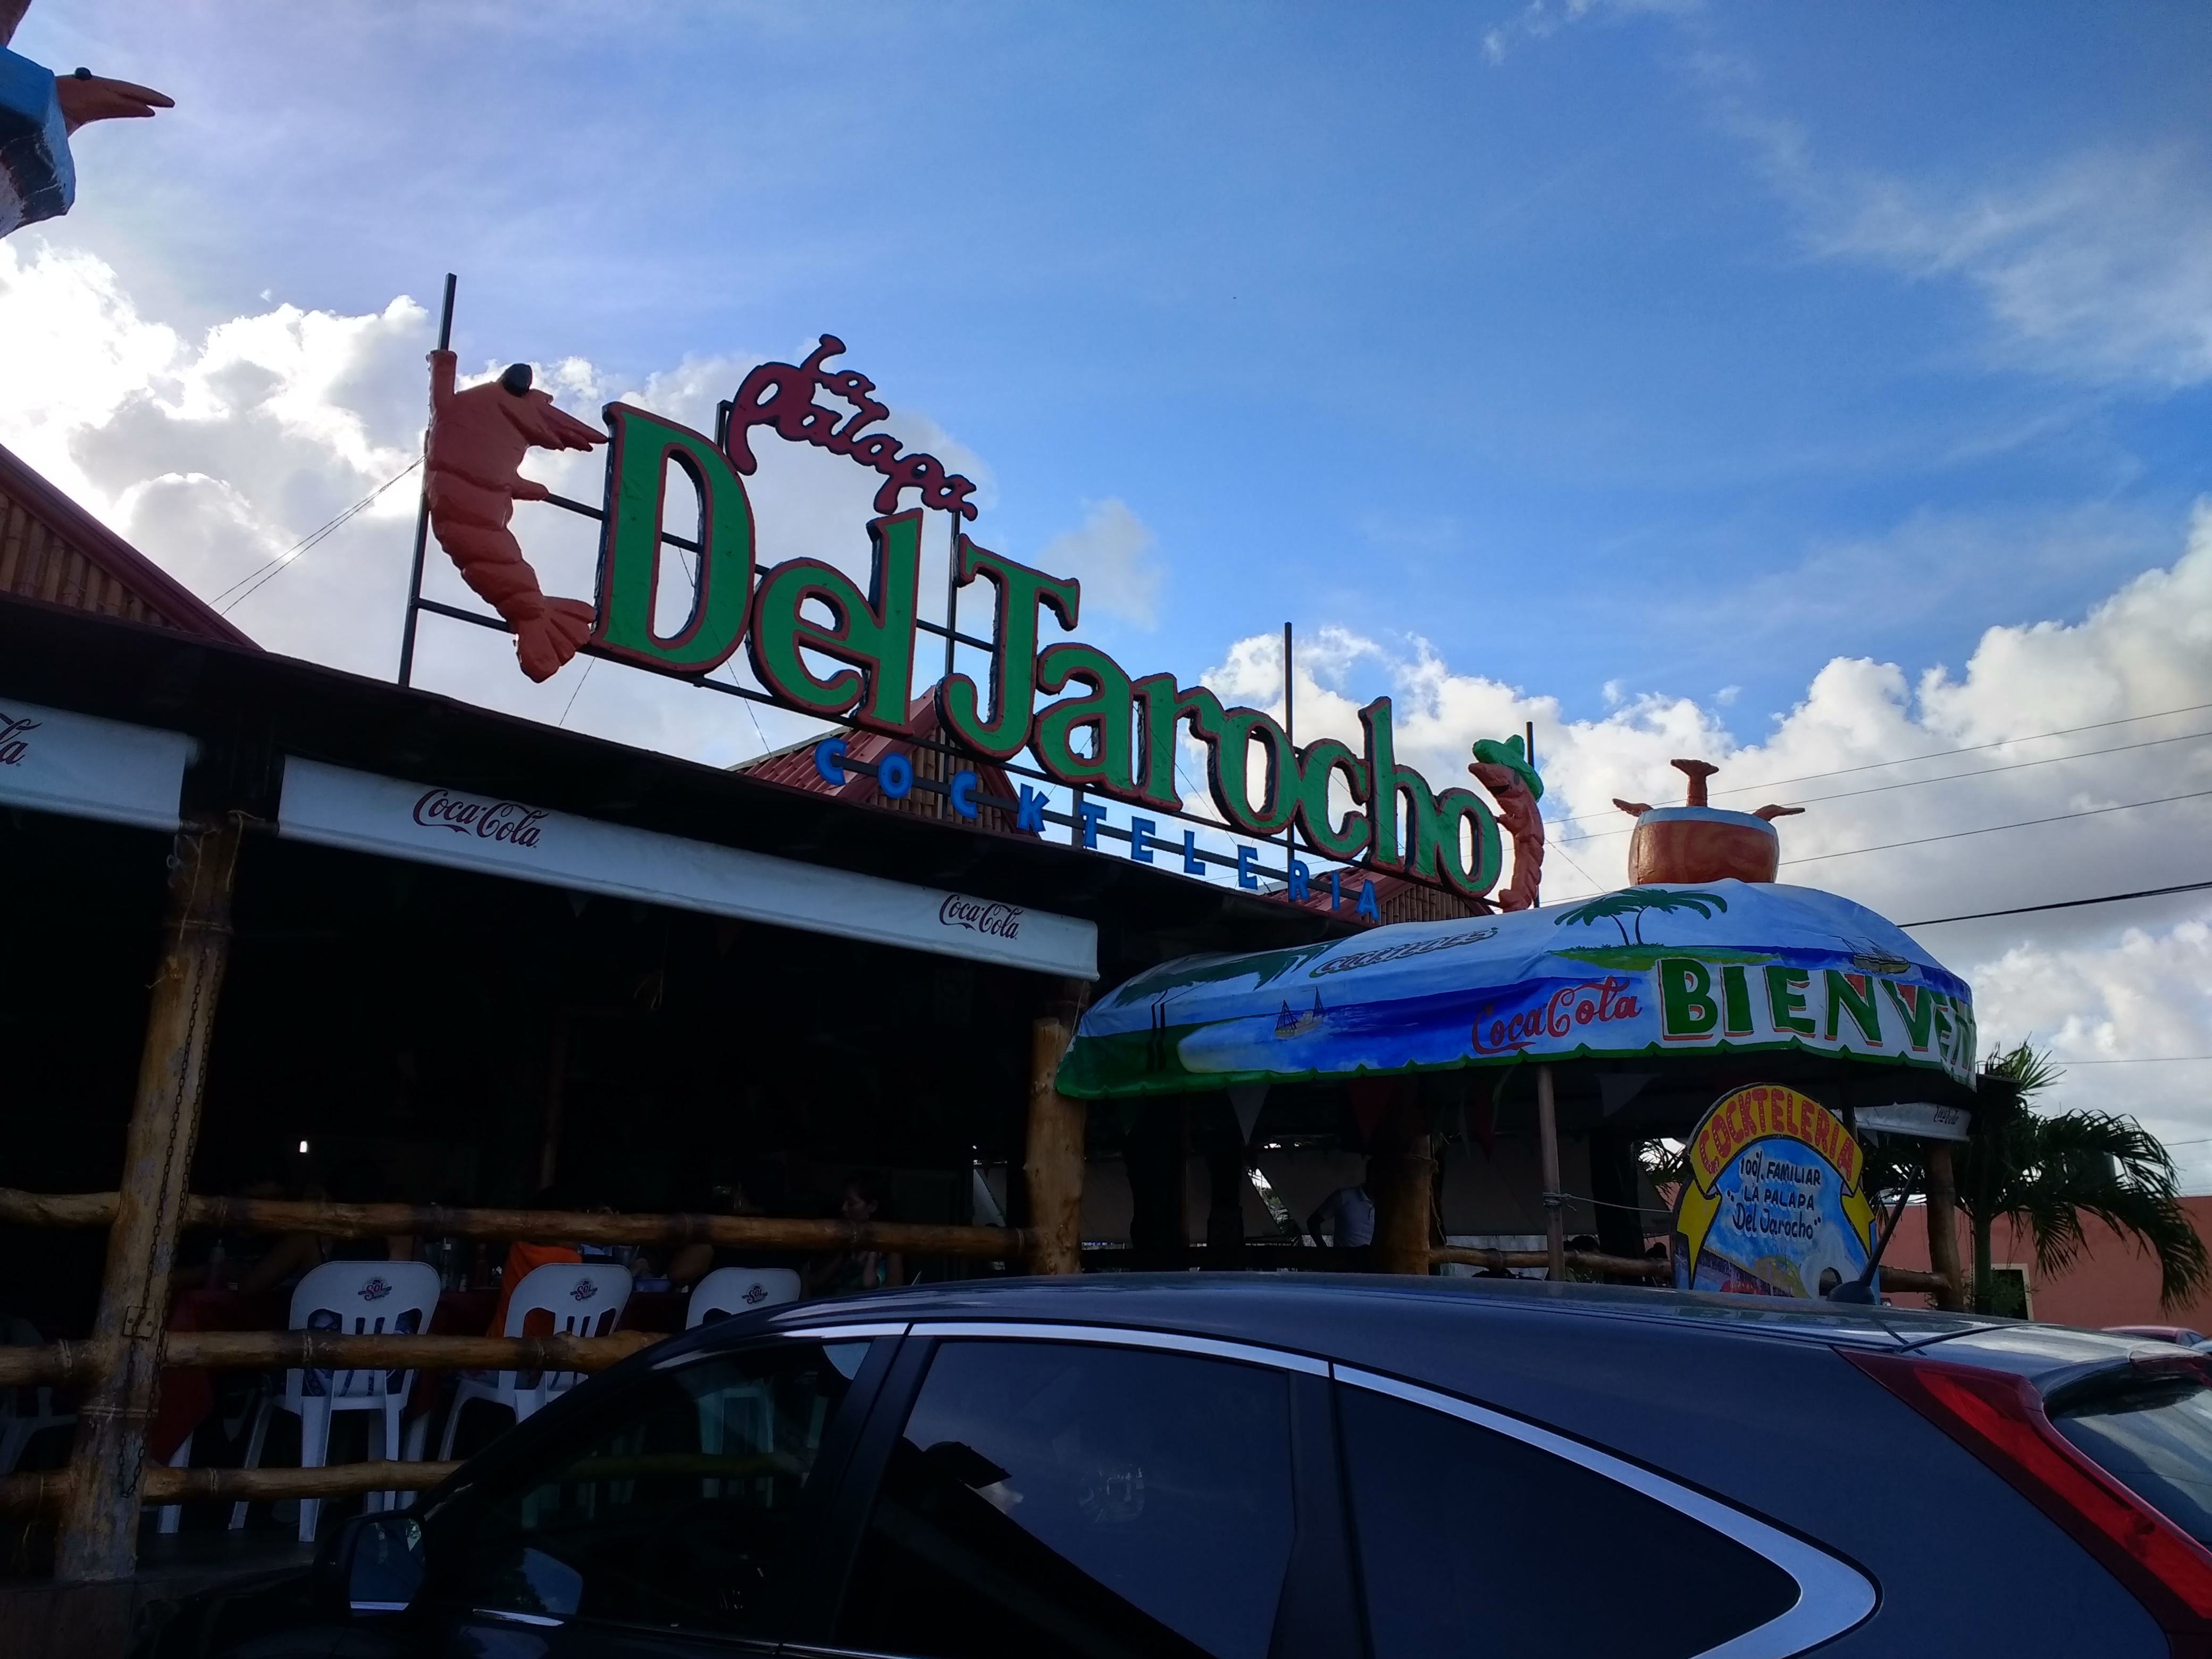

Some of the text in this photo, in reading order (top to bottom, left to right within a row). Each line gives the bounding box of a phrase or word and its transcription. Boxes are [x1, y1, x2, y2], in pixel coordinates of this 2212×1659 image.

[589, 400, 1502, 899] Del Jarocho
[413, 789, 549, 849] Coca-Cola
[815, 737, 1380, 921] COCKTELERIA
[939, 894, 1024, 940] Coca-Cola
[1699, 1088, 1855, 1182] COCKTELERIA
[1766, 1161, 1821, 1186] FAMILIAR
[1732, 1202, 1757, 1233] Del
[1764, 1188, 1814, 1211] PALAPA
[364, 1283, 386, 1301] SOL
[747, 1289, 763, 1304] SOL
